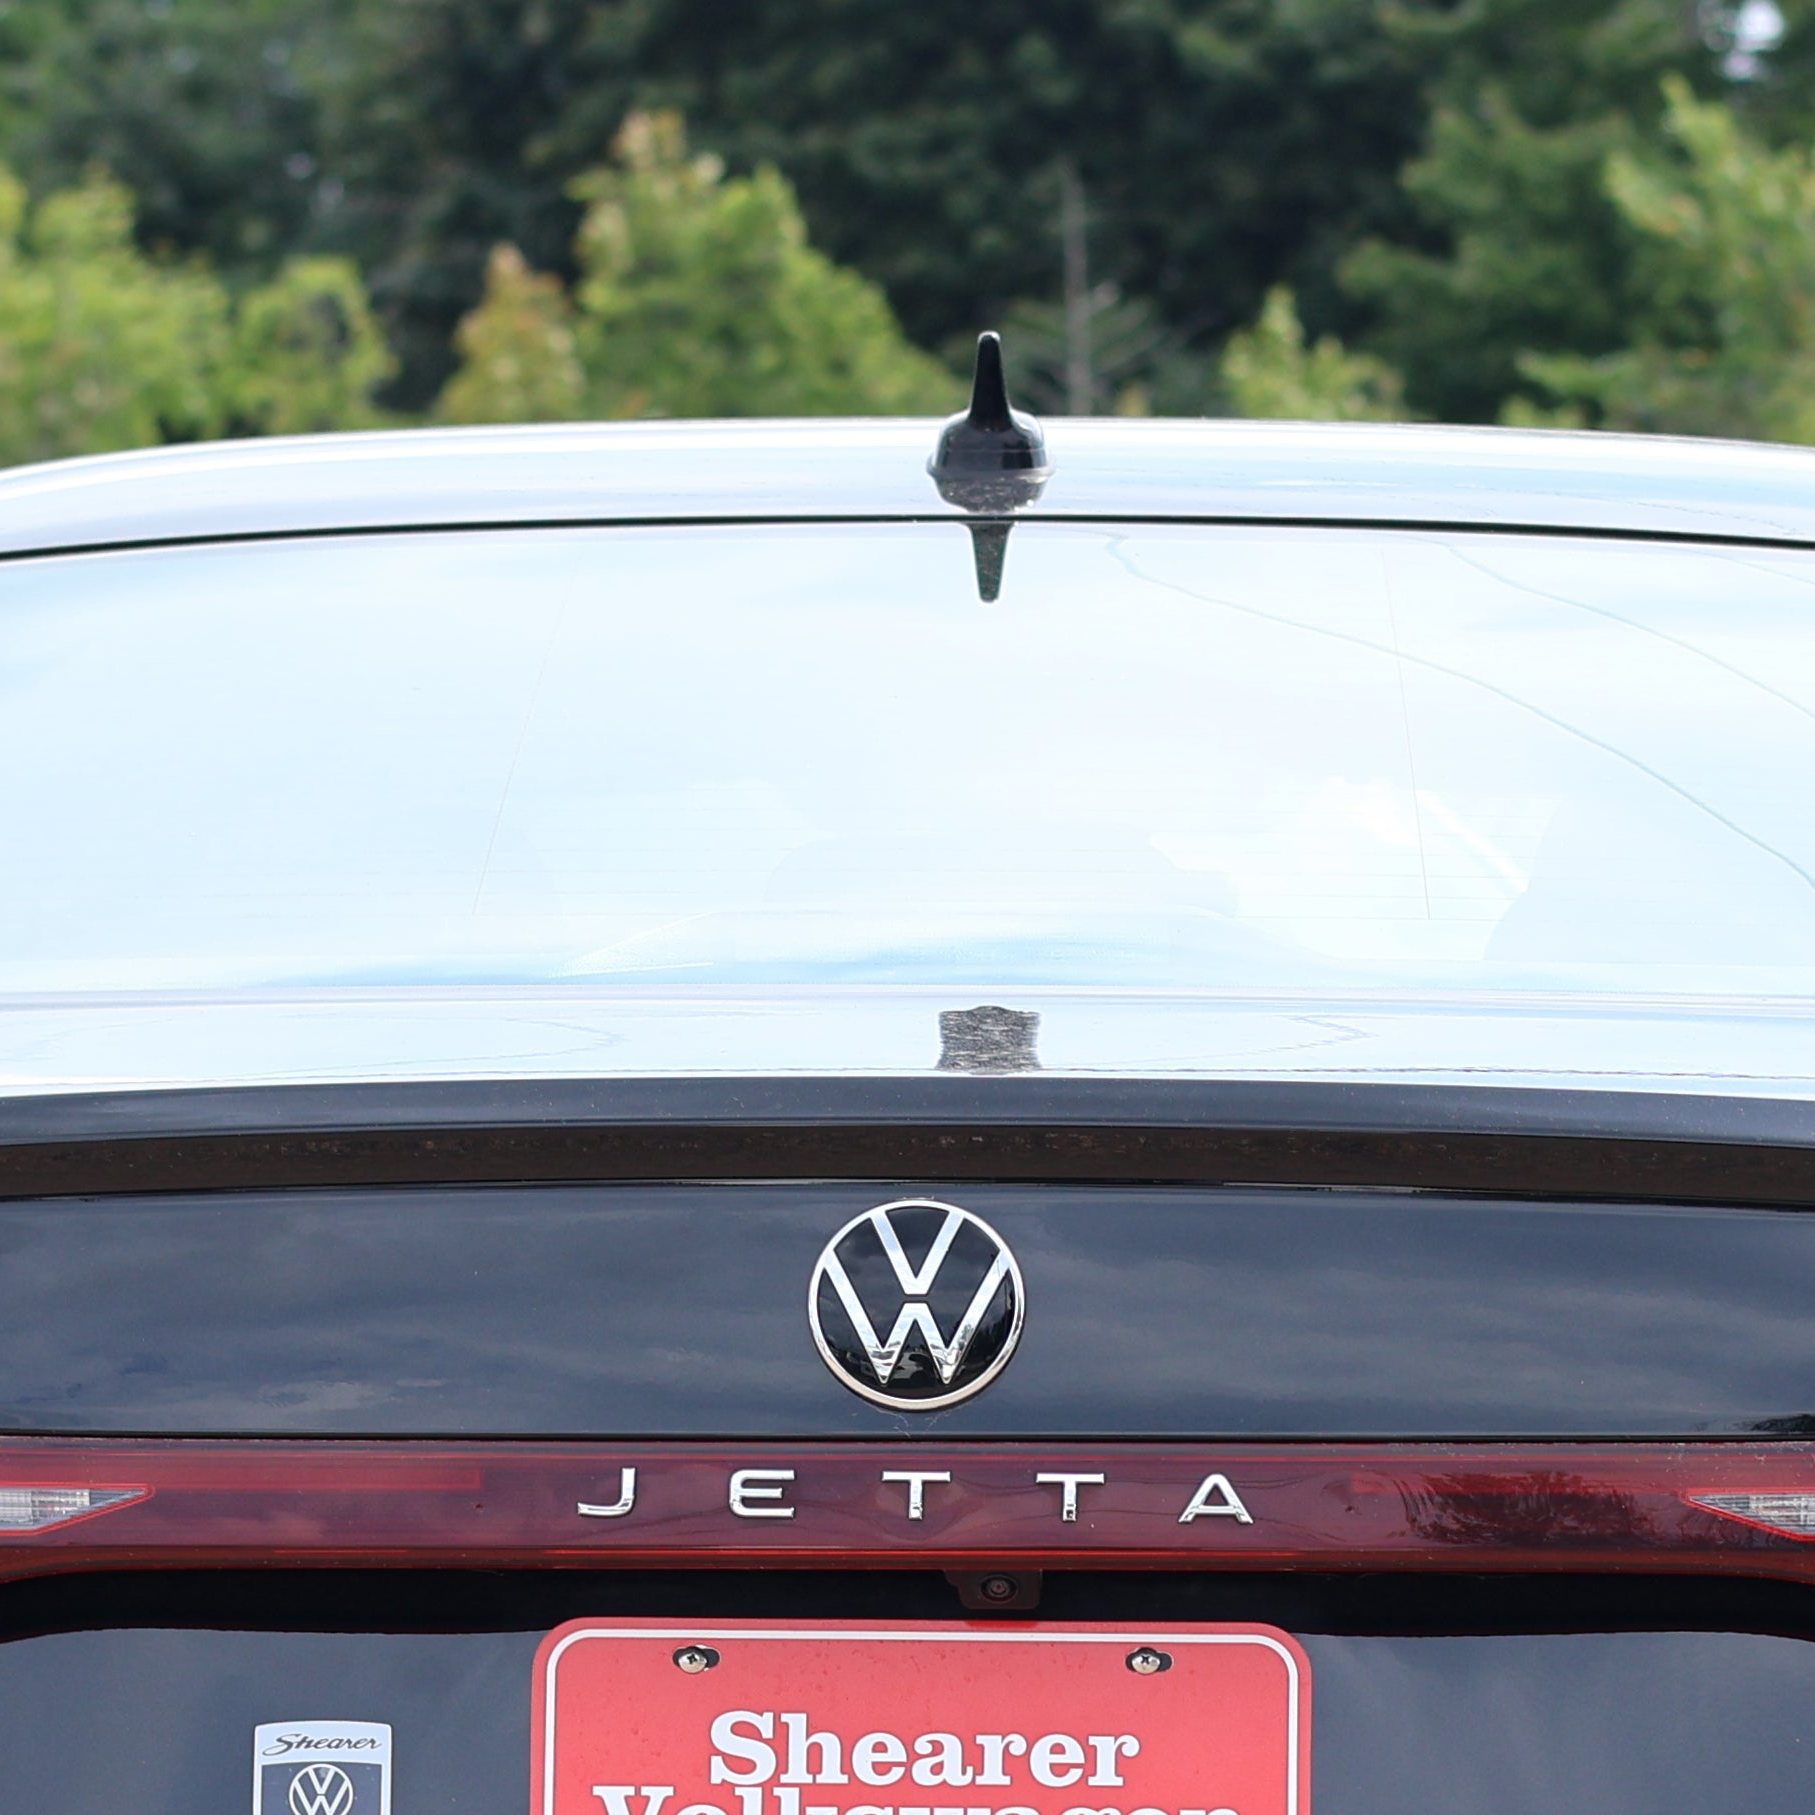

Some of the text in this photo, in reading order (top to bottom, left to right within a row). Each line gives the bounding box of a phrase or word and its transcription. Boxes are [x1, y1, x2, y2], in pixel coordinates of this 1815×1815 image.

[576, 1466, 1254, 1526] JETTA
[262, 1733, 382, 1756] Shearer
[709, 1709, 1141, 1788] Shearer
